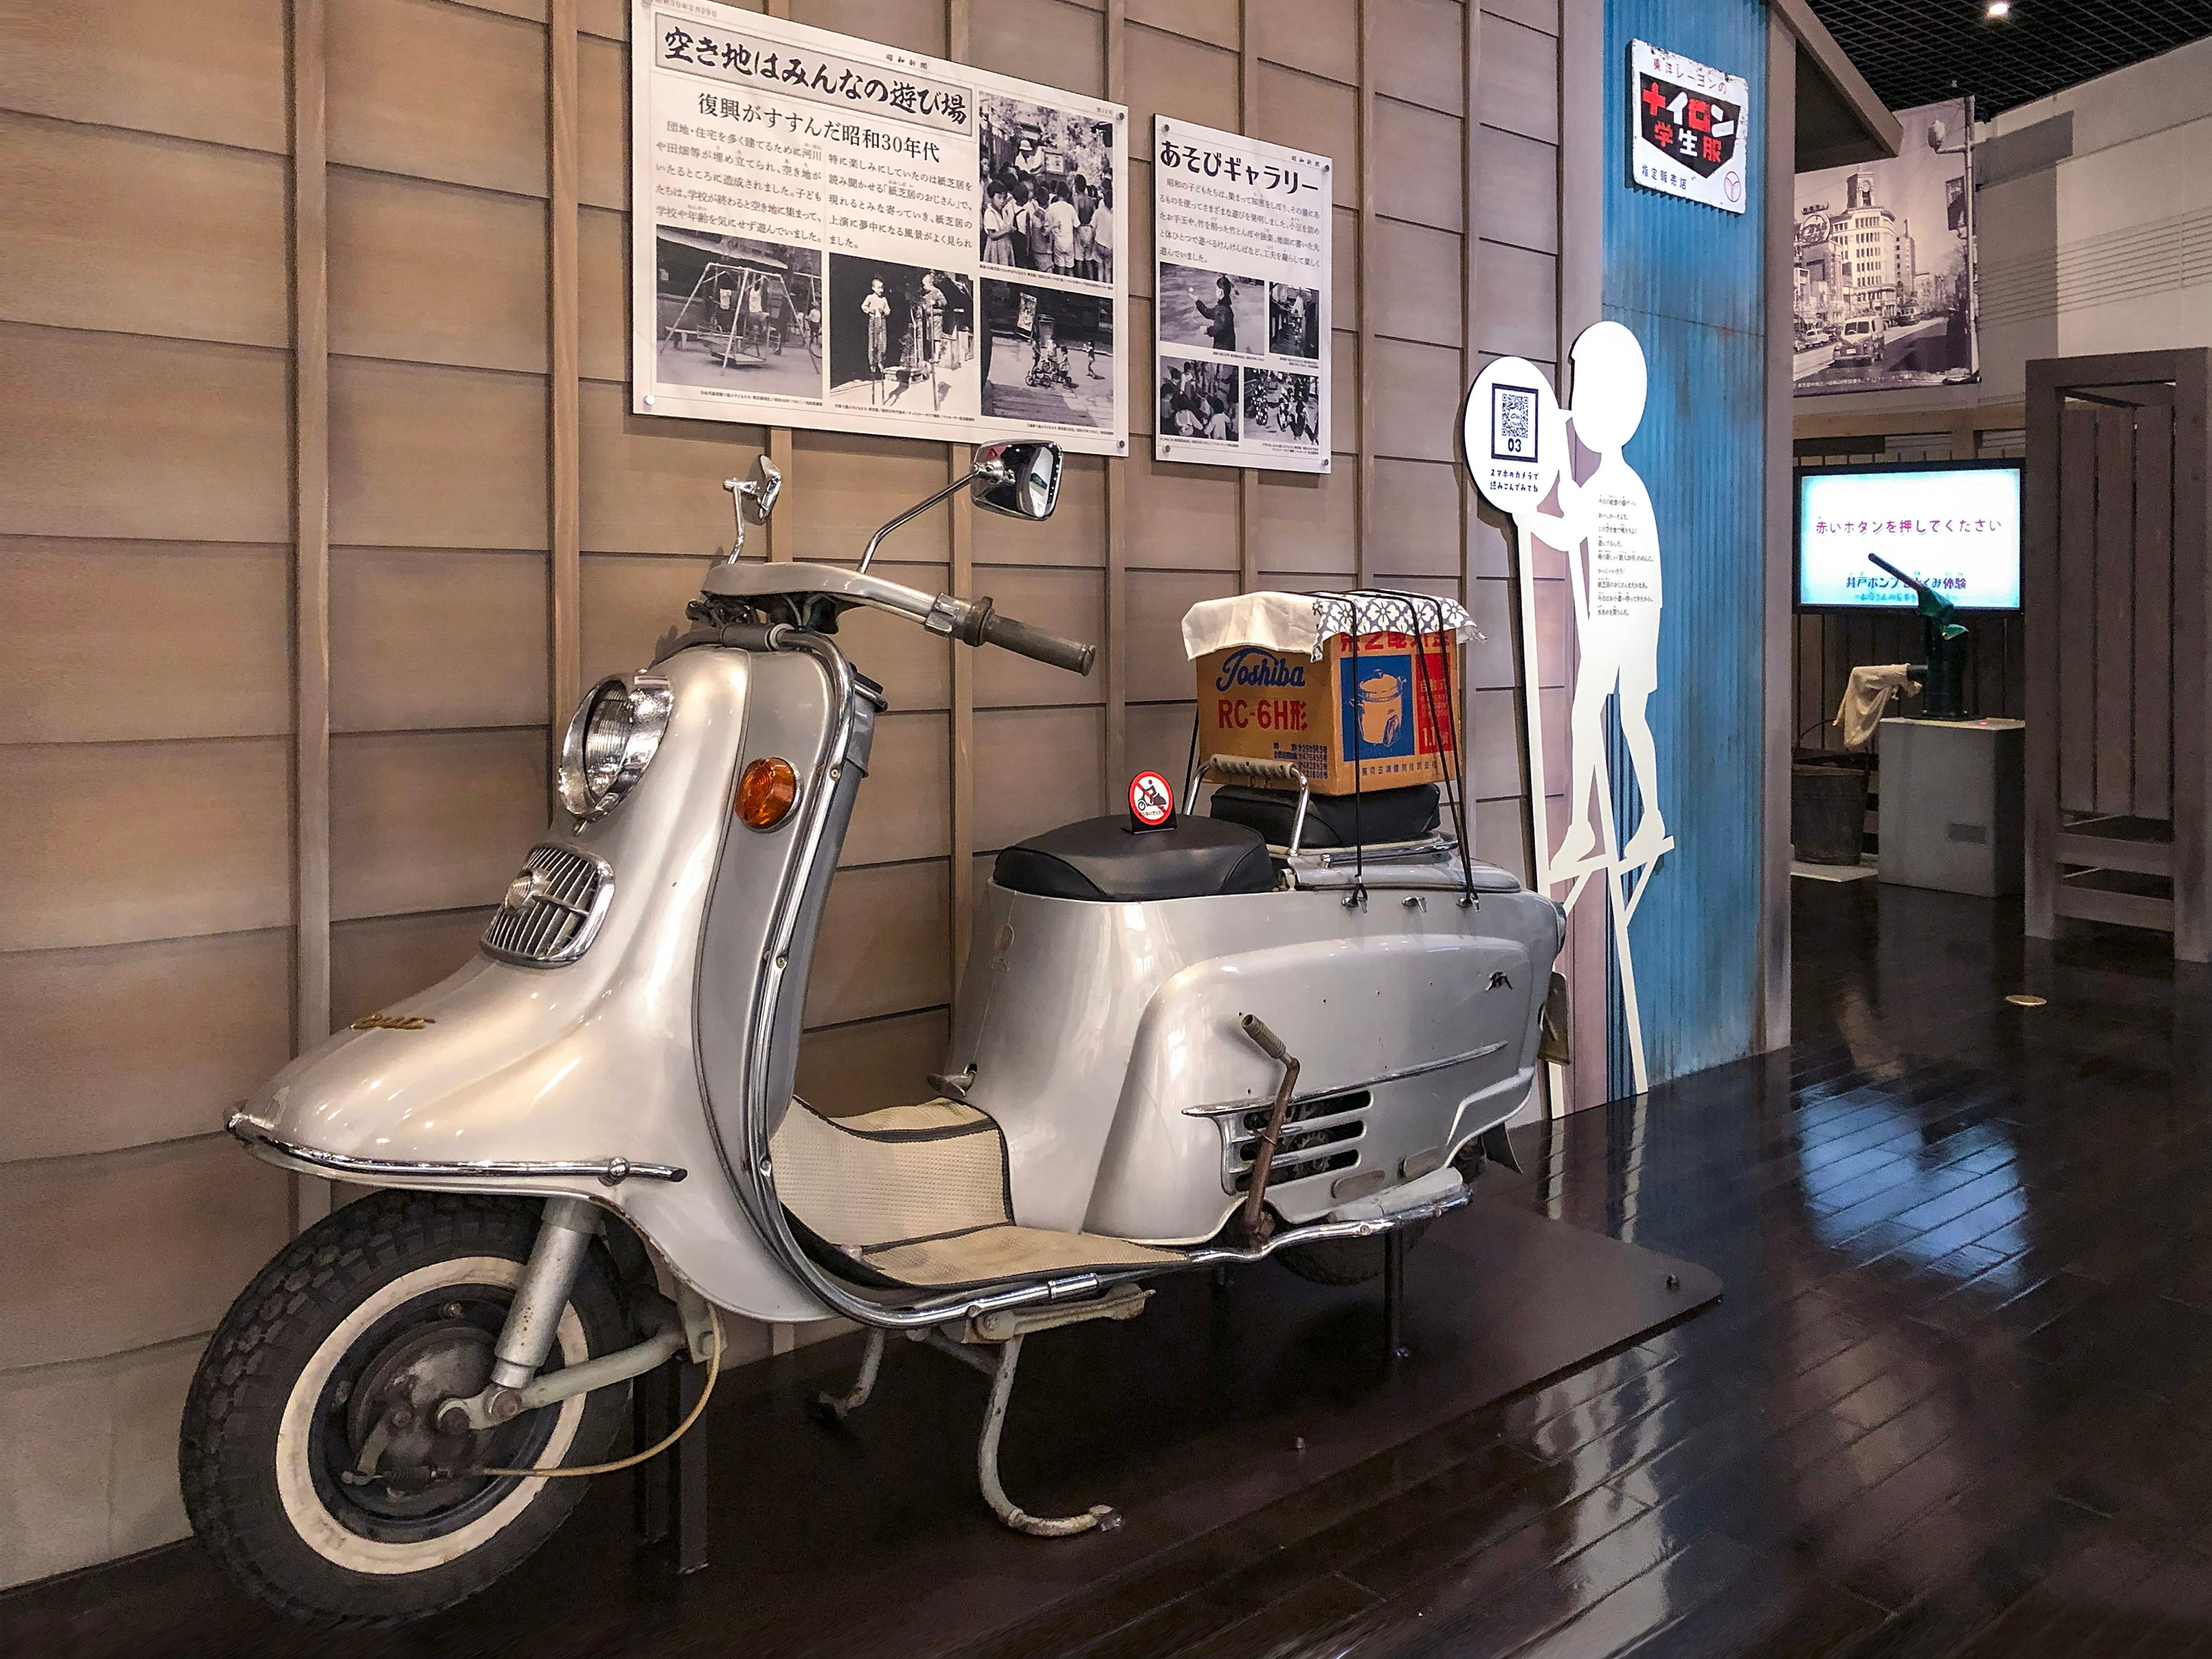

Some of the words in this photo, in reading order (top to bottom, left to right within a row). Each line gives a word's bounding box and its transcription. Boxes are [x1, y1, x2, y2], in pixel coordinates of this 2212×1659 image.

[665, 27, 966, 125] 空き地はみんなの遊び場
[699, 93, 940, 163] 復興がすすんだ昭和30年代
[1160, 140, 1319, 194] あそびギャラリー
[829, 235, 858, 249] ました。
[1159, 246, 1209, 264] 遊んでいました。
[1508, 438, 1521, 452] 03
[1491, 469, 1539, 480] スマホのカメラで
[1216, 648, 1306, 692] Toshiba
